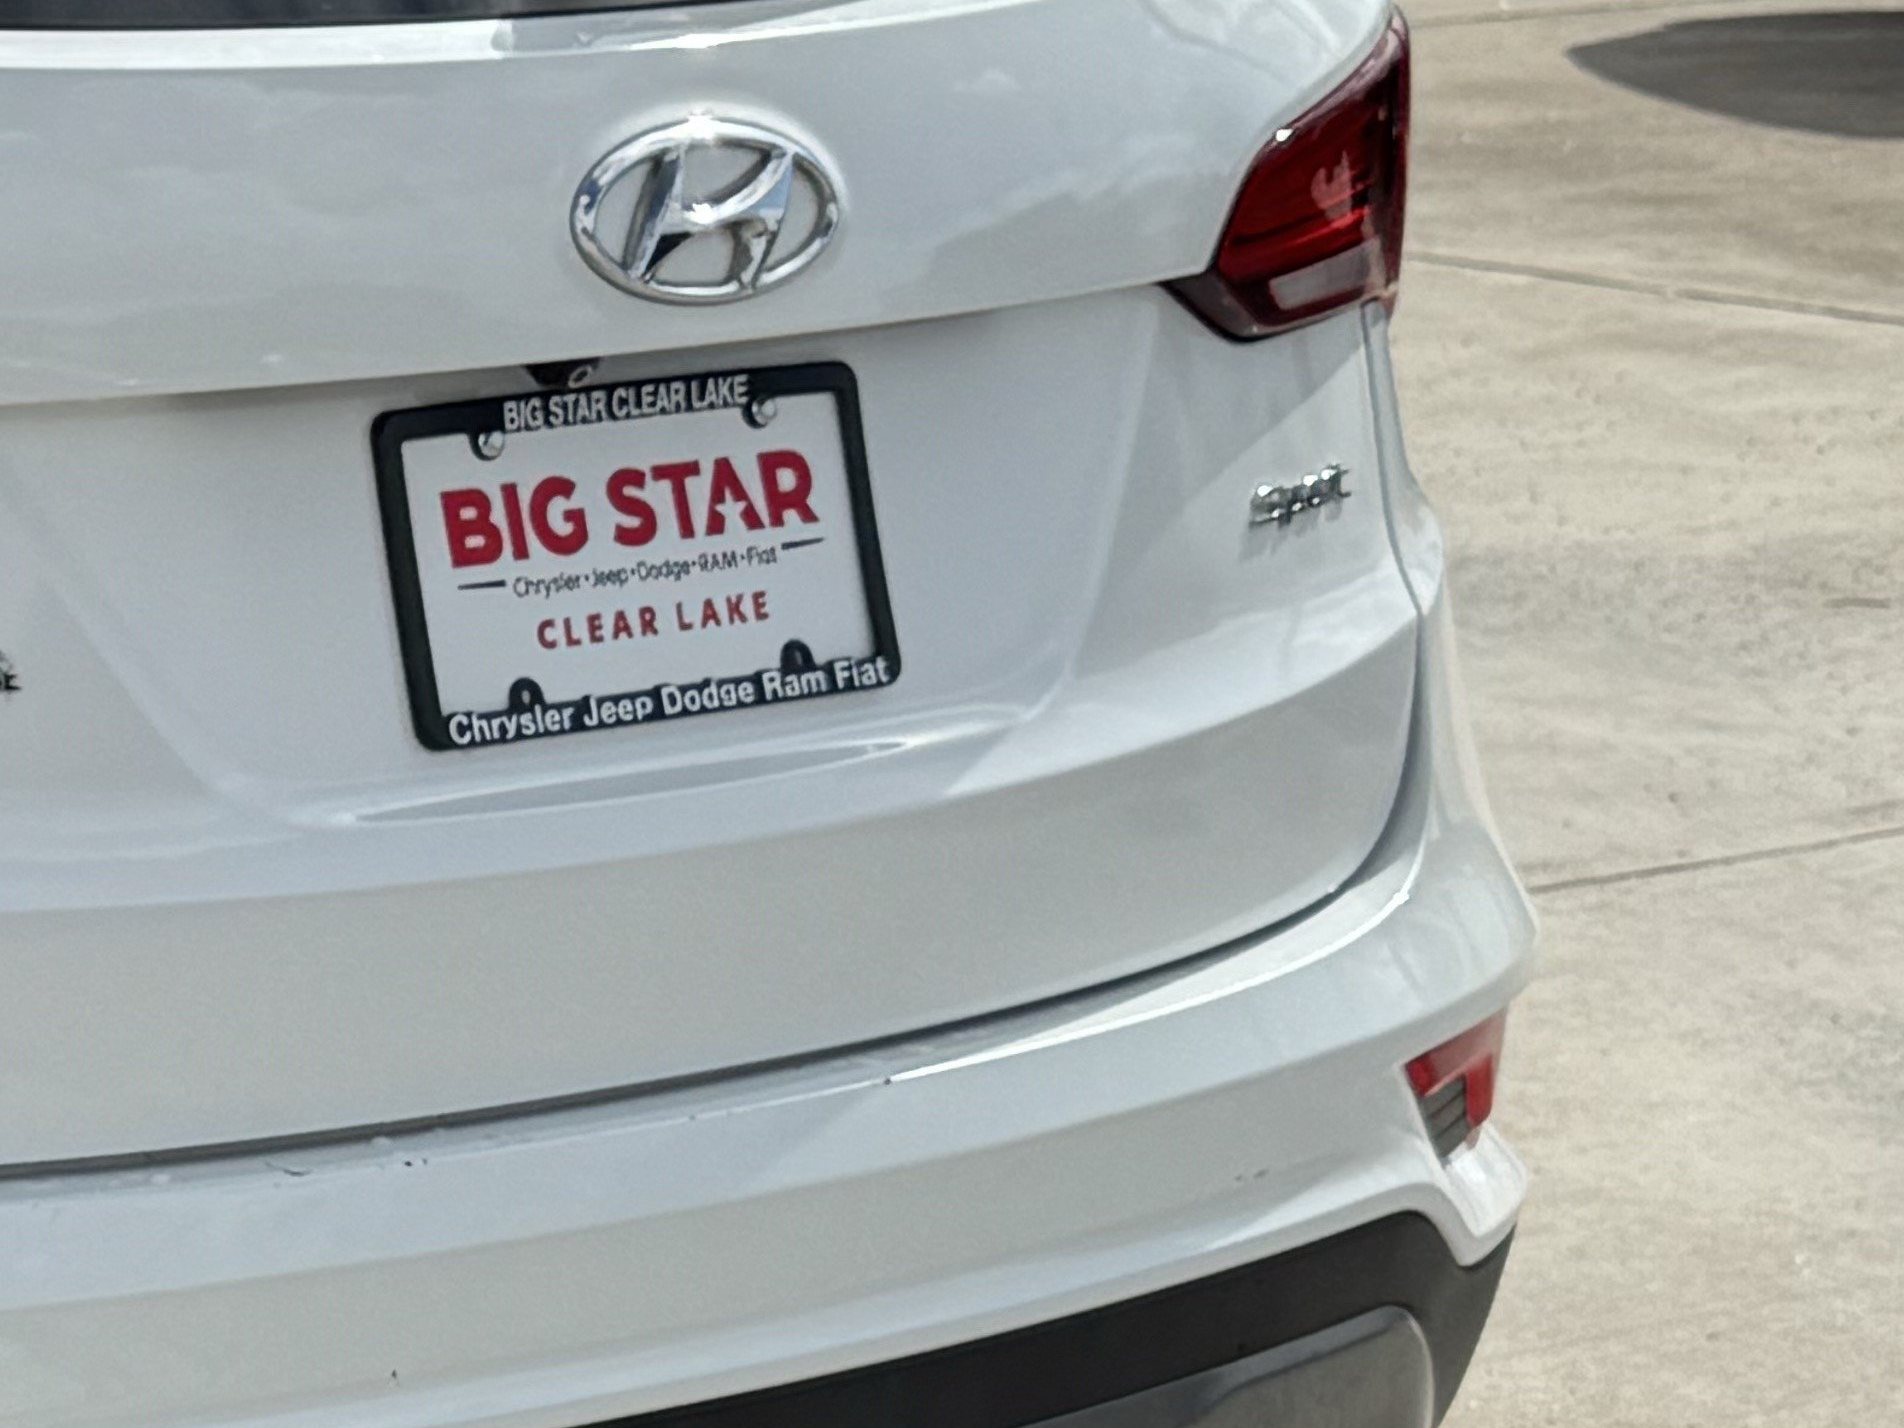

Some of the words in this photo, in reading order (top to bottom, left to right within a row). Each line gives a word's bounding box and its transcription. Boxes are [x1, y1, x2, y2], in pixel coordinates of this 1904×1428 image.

[503, 397, 542, 431] BIG
[548, 390, 607, 425] STAR
[611, 380, 686, 419] CLEAR
[691, 374, 749, 409] LAKE
[439, 473, 590, 569] BIG
[605, 449, 820, 546] STAR
[537, 605, 659, 650] CLEAR
[675, 590, 770, 632] LAKE
[448, 702, 575, 746] Chrysler
[583, 693, 653, 728] Jeep
[660, 676, 756, 718] Dodge
[761, 667, 828, 700] Ram
[833, 655, 891, 689] Fiat
